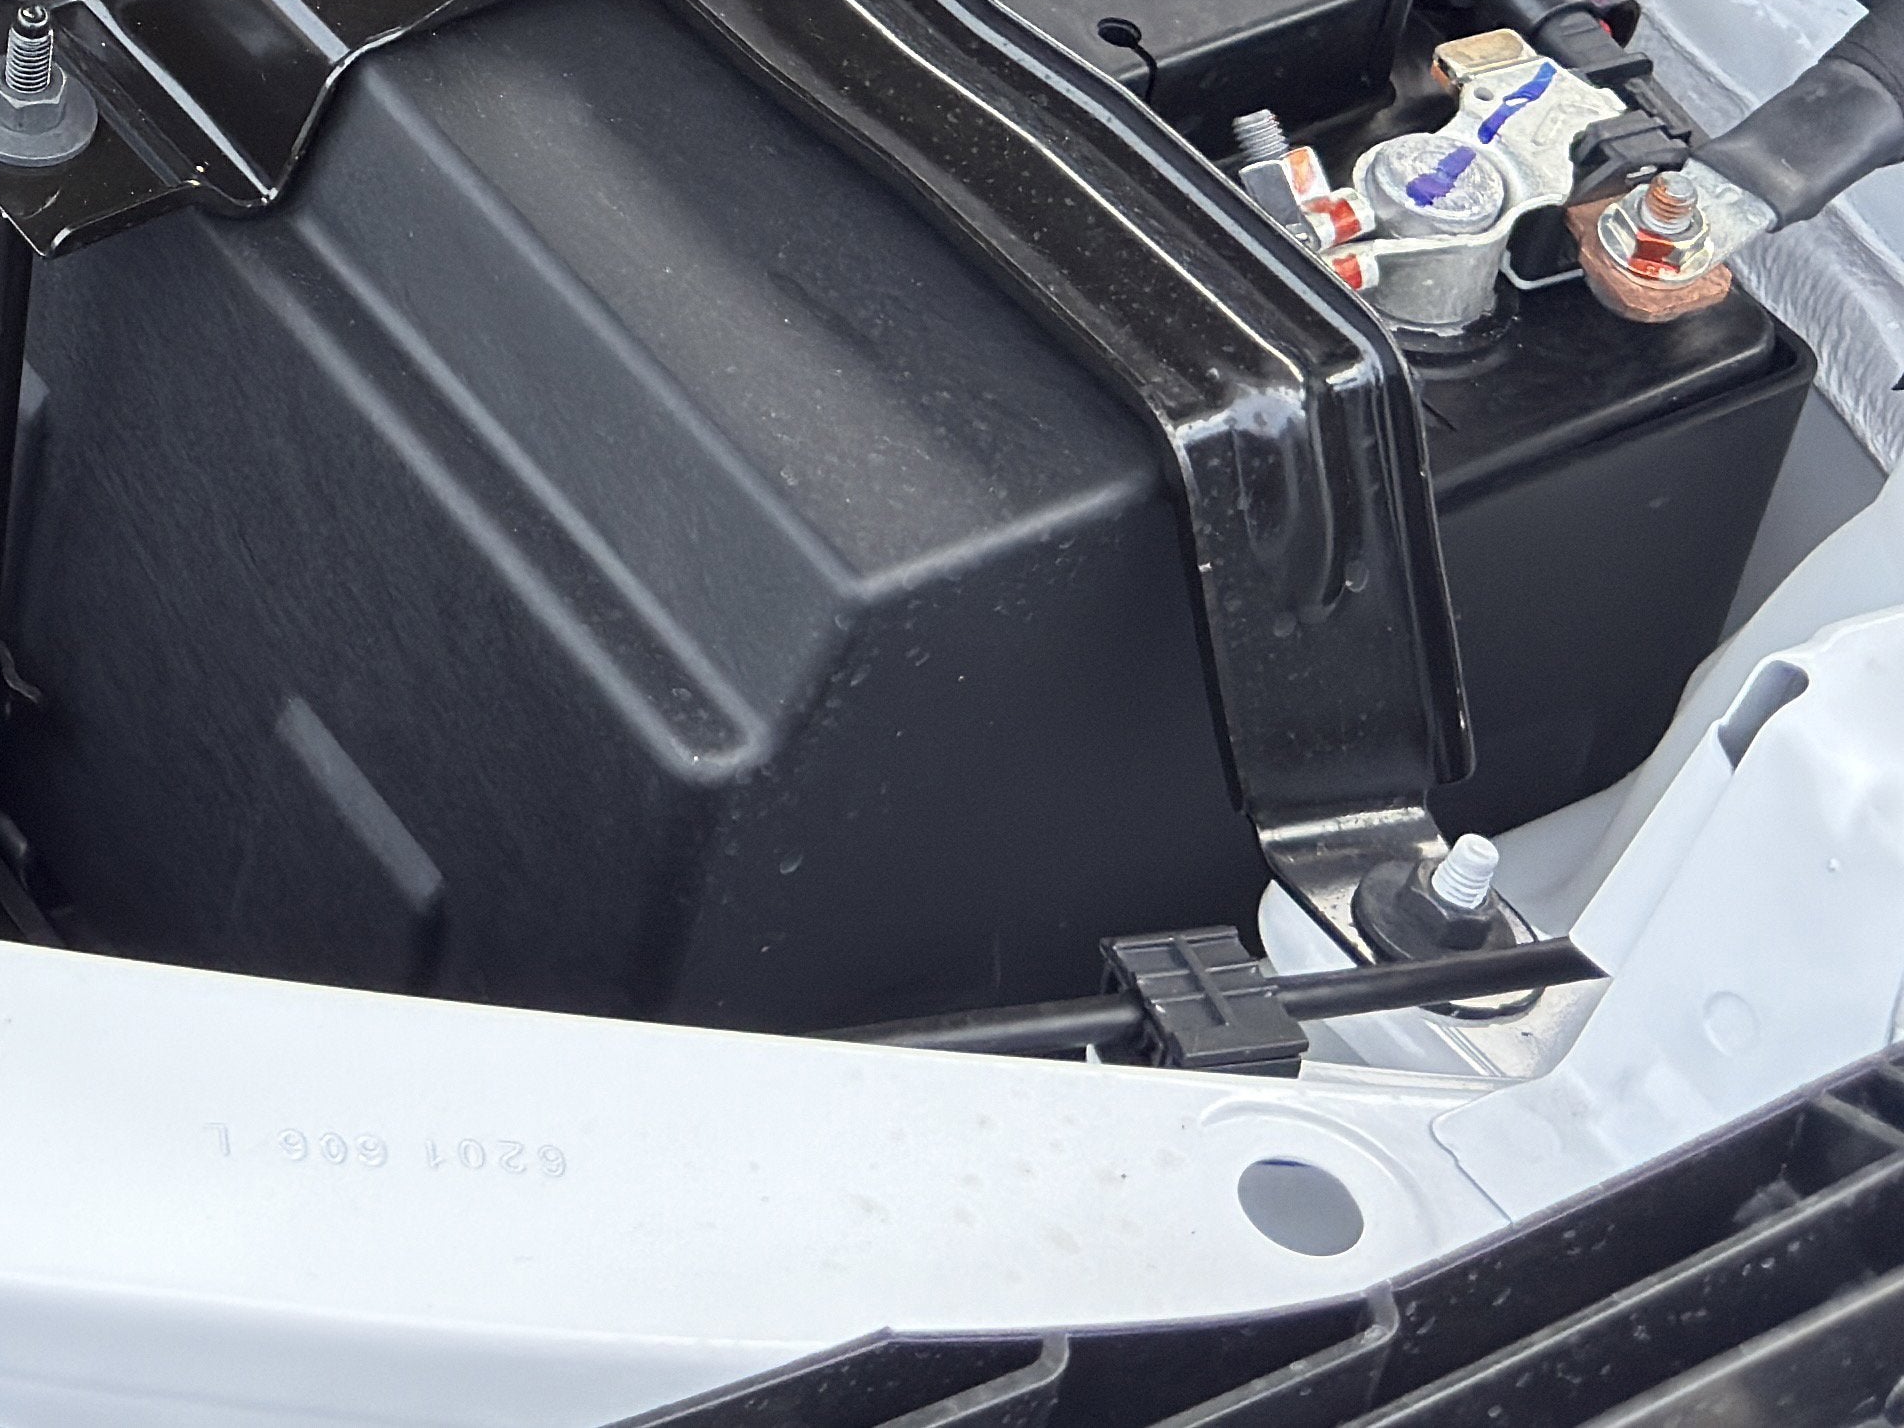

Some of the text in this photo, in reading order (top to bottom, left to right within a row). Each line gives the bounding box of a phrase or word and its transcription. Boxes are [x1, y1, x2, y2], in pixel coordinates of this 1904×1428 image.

[203, 1121, 567, 1178] 6201 606 L
